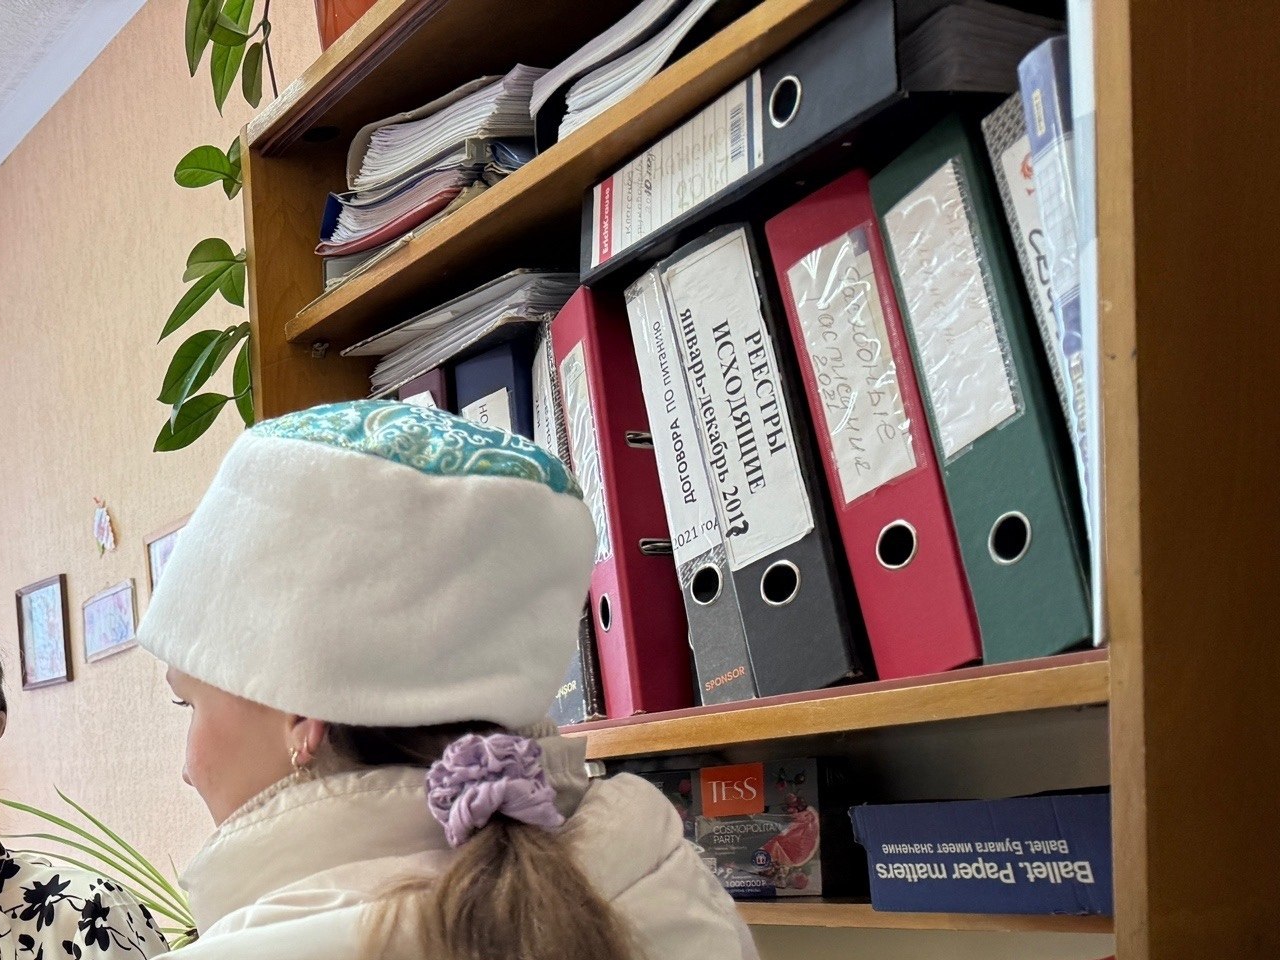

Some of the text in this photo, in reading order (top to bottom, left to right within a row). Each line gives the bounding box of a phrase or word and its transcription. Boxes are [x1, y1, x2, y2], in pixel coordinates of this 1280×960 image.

[601, 186, 611, 255] ErichKrause
[652, 321, 697, 504] ДОГОВОРА ПО питанию
[679, 308, 730, 483] январь-декабрь
[712, 319, 766, 495] ИСХОДЯЩИЕ
[744, 328, 787, 457] РЕЕСТРЫ
[812, 353, 839, 413] 2021
[704, 665, 746, 692] SPONSOR
[708, 776, 757, 804] TESS
[713, 834, 741, 844] PARTY
[881, 838, 1070, 855] Ballet. Бумага имеет значение
[875, 857, 1095, 884] Ballet. Paper matters
